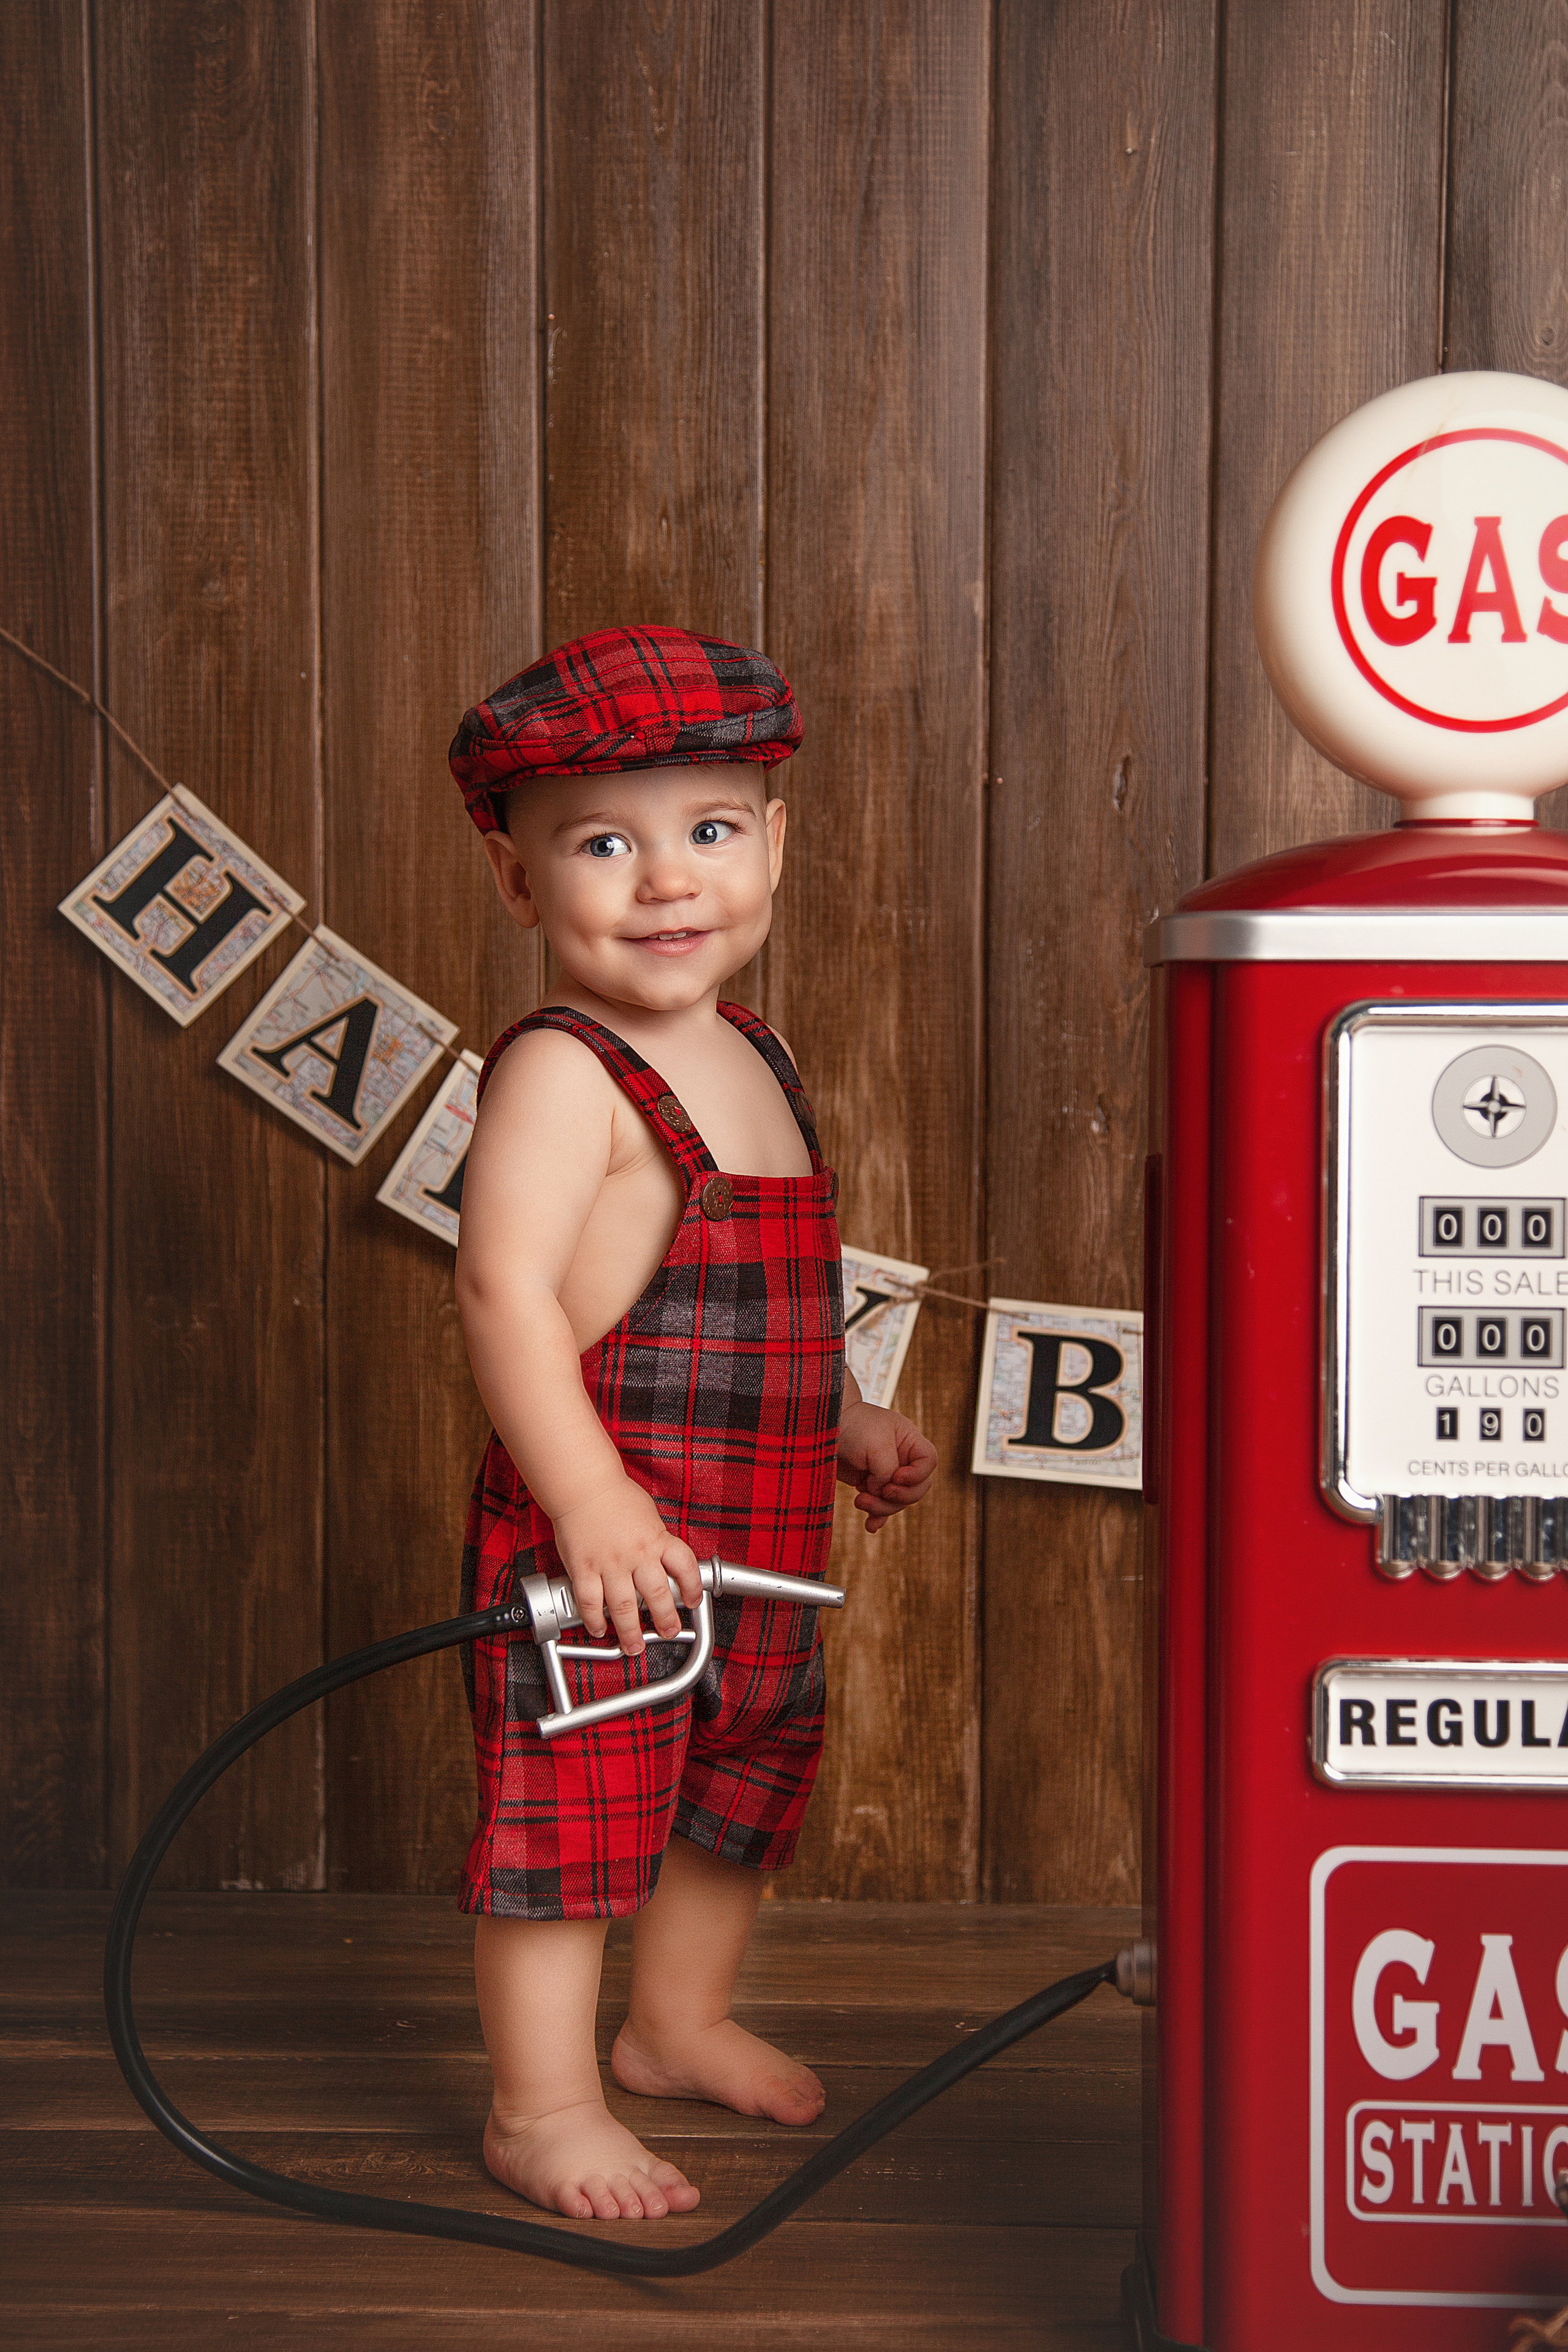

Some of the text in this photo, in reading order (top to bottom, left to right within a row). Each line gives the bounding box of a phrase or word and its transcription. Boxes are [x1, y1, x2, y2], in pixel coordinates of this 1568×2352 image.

[1413, 1269, 1568, 1295] THIS SALE
[1425, 1374, 1559, 1398] GALLONS
[1408, 1459, 1470, 1476] CENTS
[1474, 1460, 1510, 1477] PER
[1339, 1698, 1568, 1748] REGUL
[1352, 1928, 1568, 2082] GA
